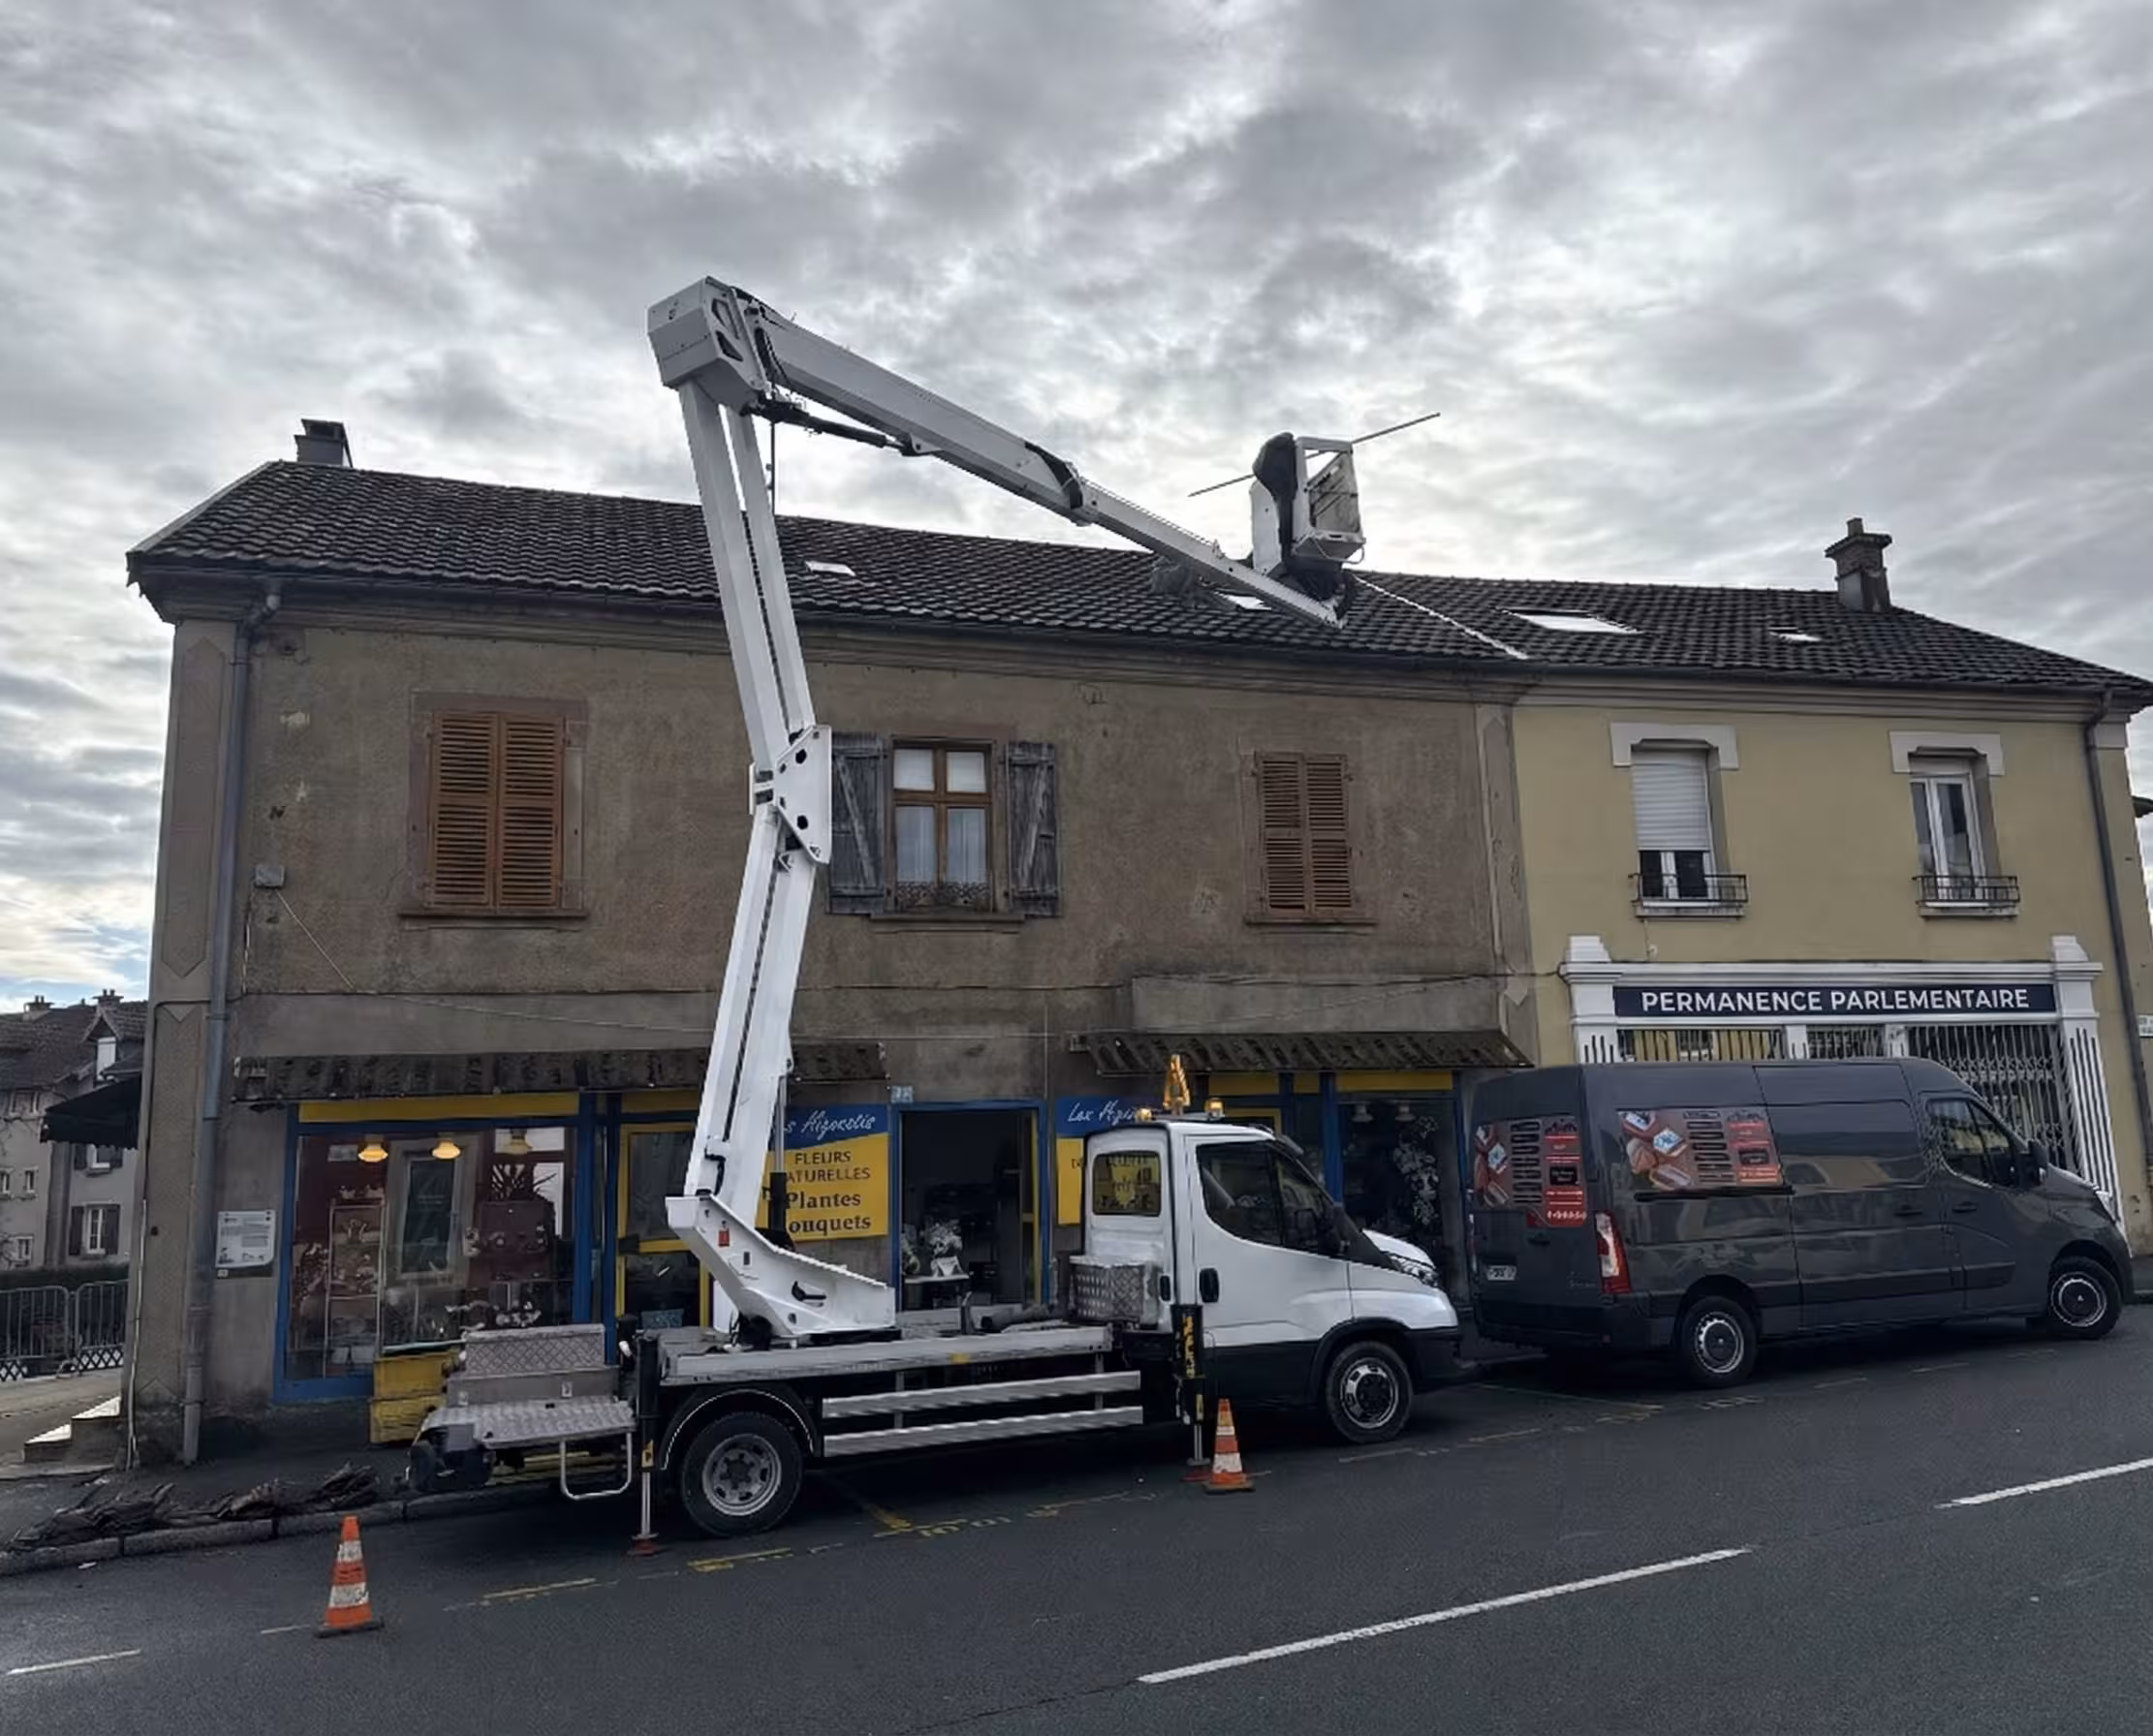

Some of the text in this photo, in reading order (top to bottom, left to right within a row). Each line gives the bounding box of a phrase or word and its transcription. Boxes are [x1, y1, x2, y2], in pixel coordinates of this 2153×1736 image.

[1641, 988, 2030, 1011] PERMANENCE PARLEMENTAIRE
[795, 1151, 852, 1165] FLEURS
[785, 1166, 871, 1184] ATURELLES
[785, 1191, 861, 1209] Plantes
[788, 1215, 872, 1236] ouquets
